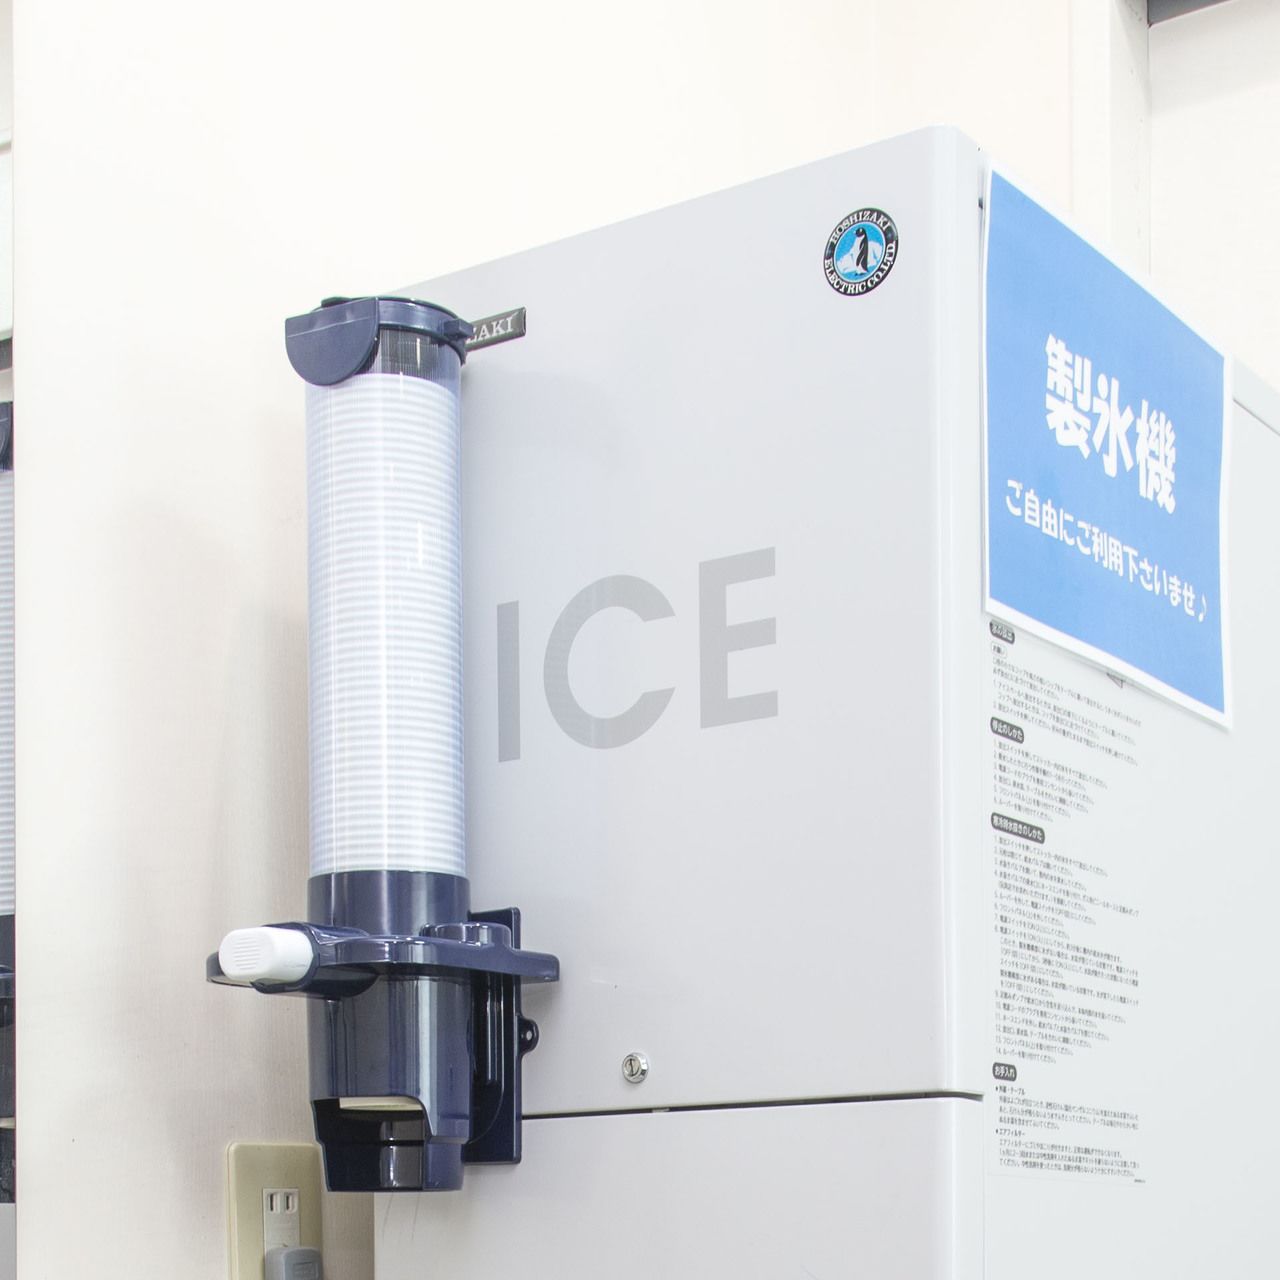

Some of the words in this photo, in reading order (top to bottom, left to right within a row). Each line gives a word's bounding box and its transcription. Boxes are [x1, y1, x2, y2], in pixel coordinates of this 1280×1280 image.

[824, 257, 867, 295] ELECTRIC
[830, 209, 891, 245] HOSHIZAKI
[1045, 332, 1177, 515] 製氷機
[496, 545, 779, 764] ICE
